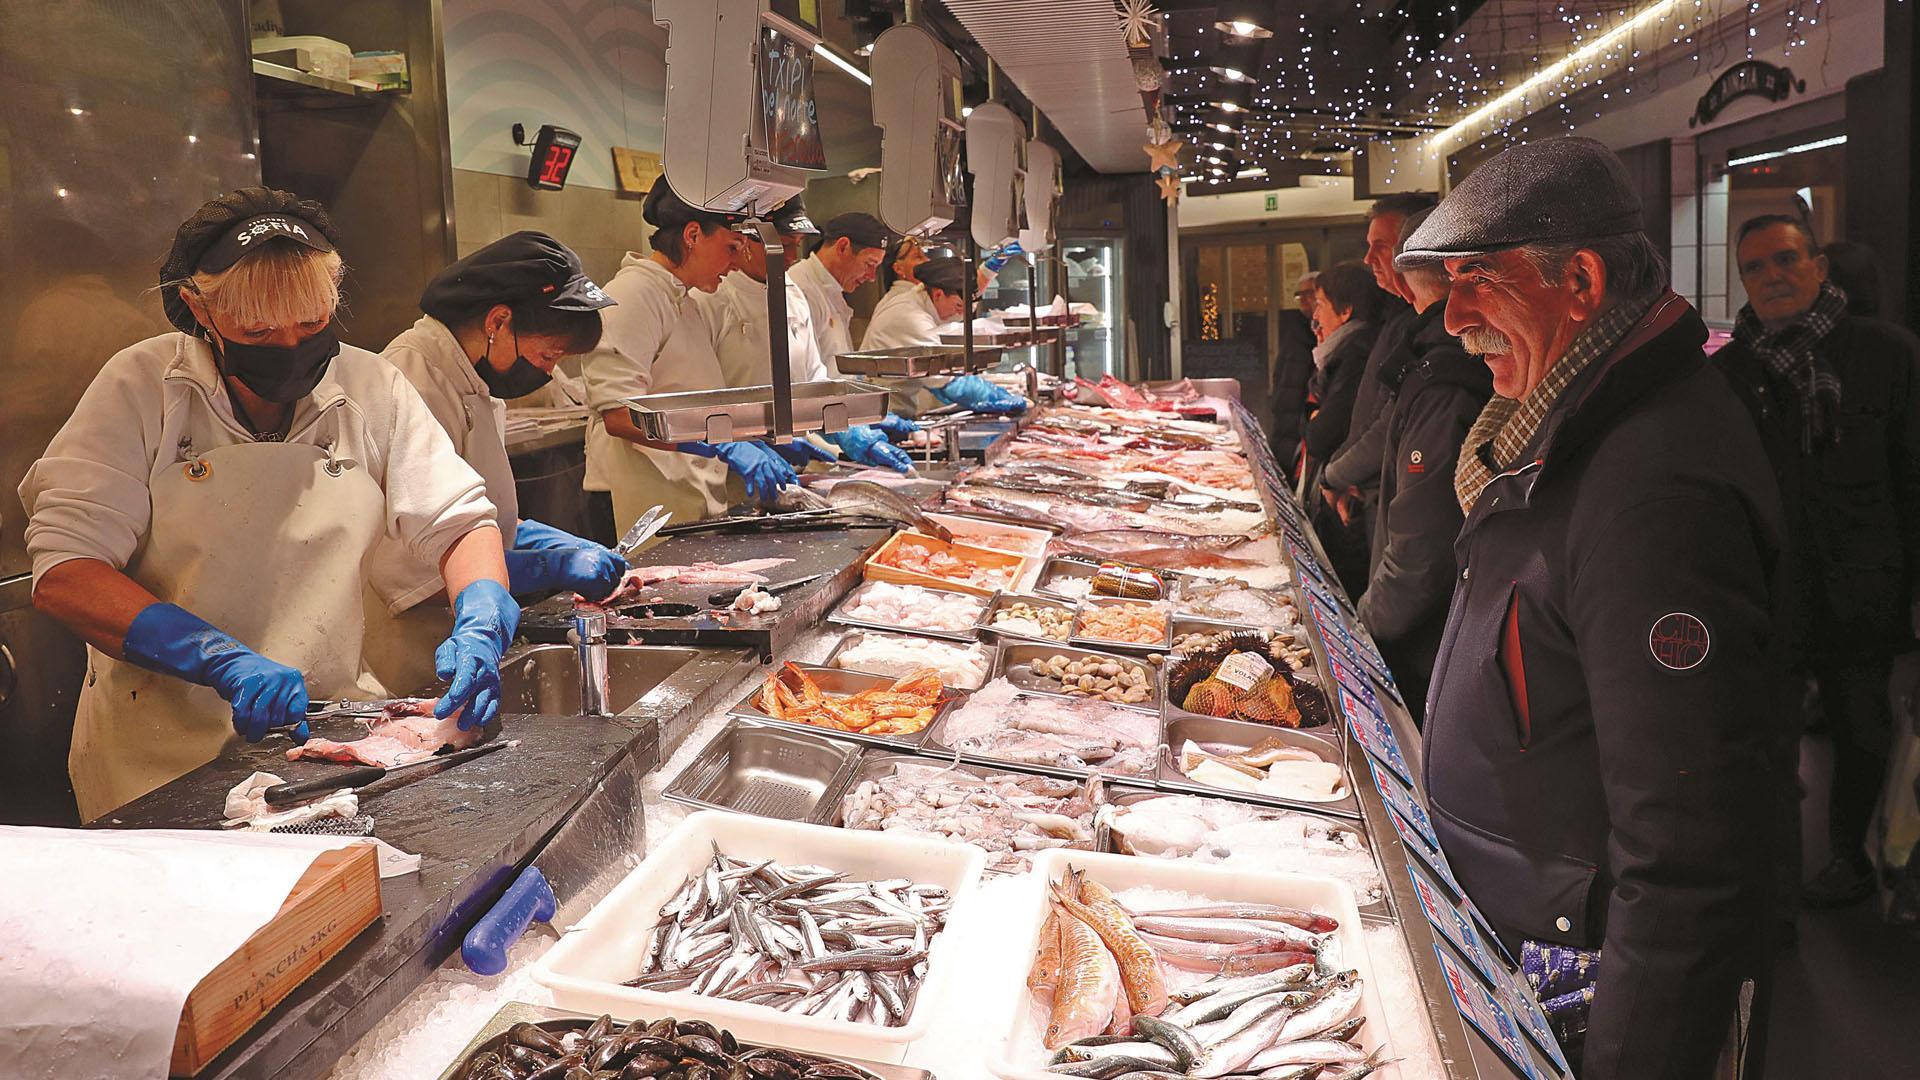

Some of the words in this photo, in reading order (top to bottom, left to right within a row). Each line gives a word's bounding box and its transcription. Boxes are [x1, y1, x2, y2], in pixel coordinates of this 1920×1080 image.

[540, 145, 573, 183] 32
[233, 945, 307, 1009] PLANCHA
[309, 918, 337, 947] 2KG
